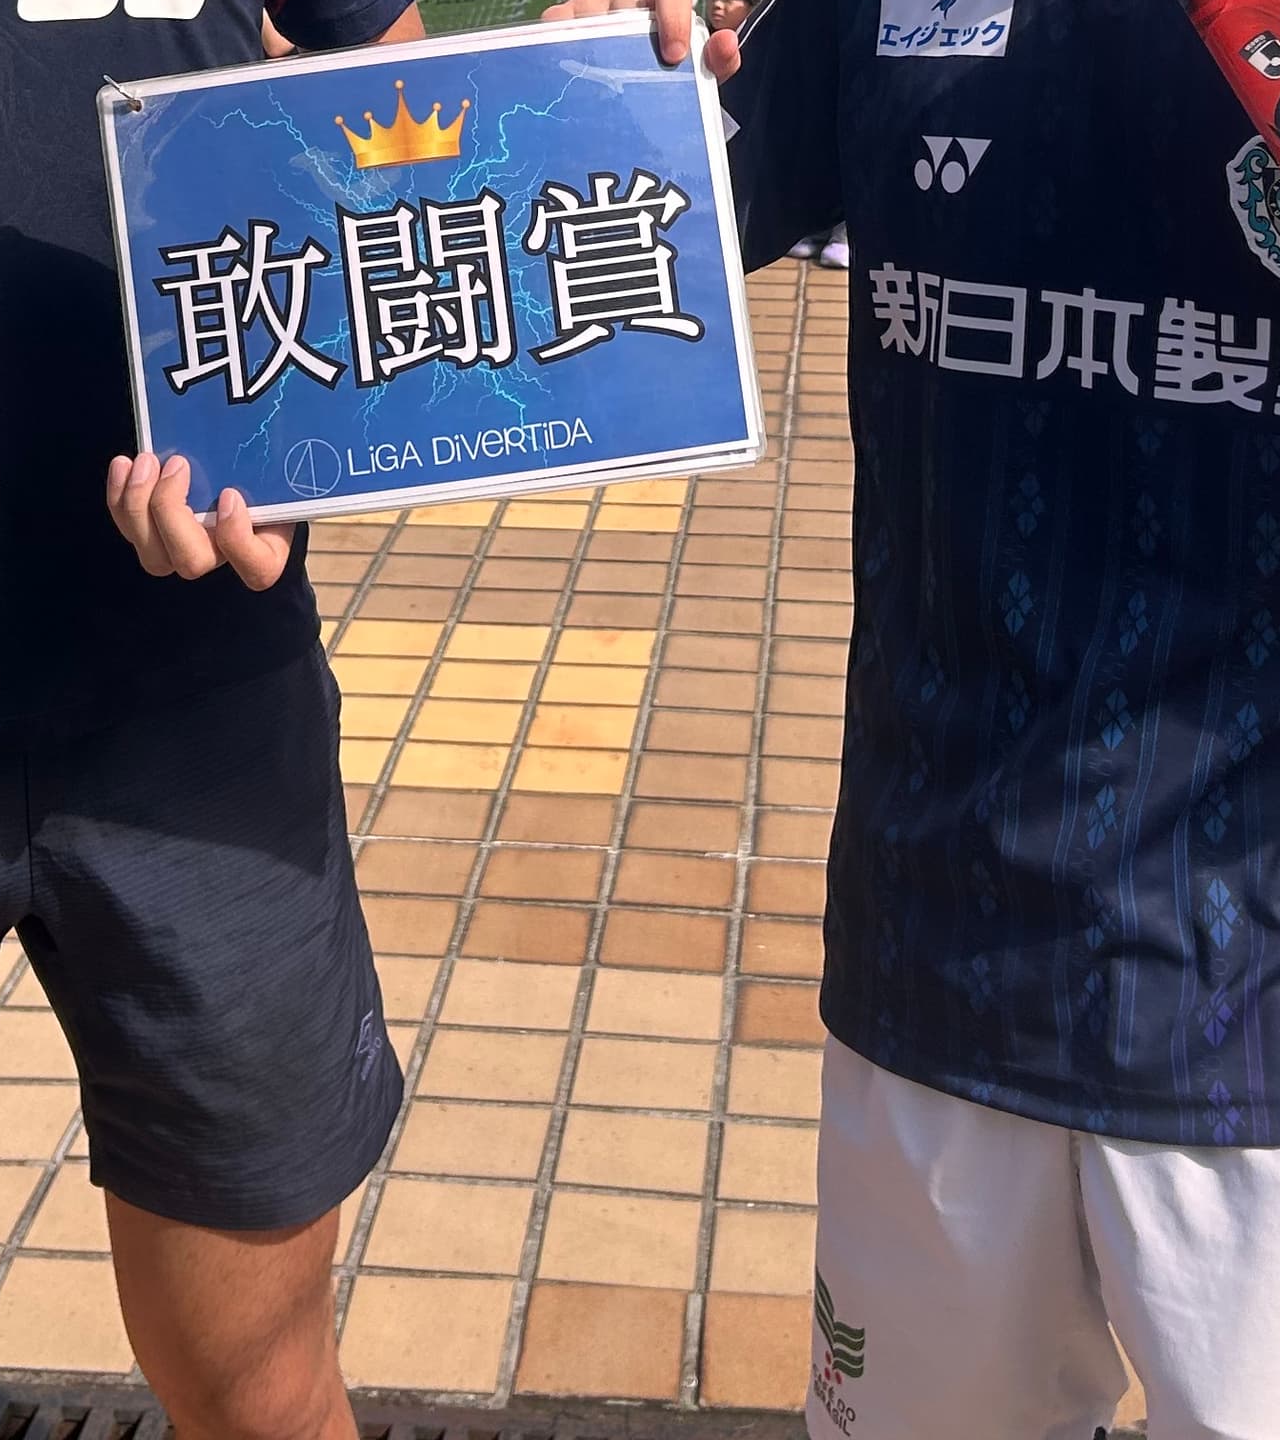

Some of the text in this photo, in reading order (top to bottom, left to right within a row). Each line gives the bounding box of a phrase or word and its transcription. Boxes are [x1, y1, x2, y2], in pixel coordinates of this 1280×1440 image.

[879, 21, 1007, 49] エイジェック
[158, 167, 705, 406] 敢闘賞
[837, 1398, 856, 1422] DO
